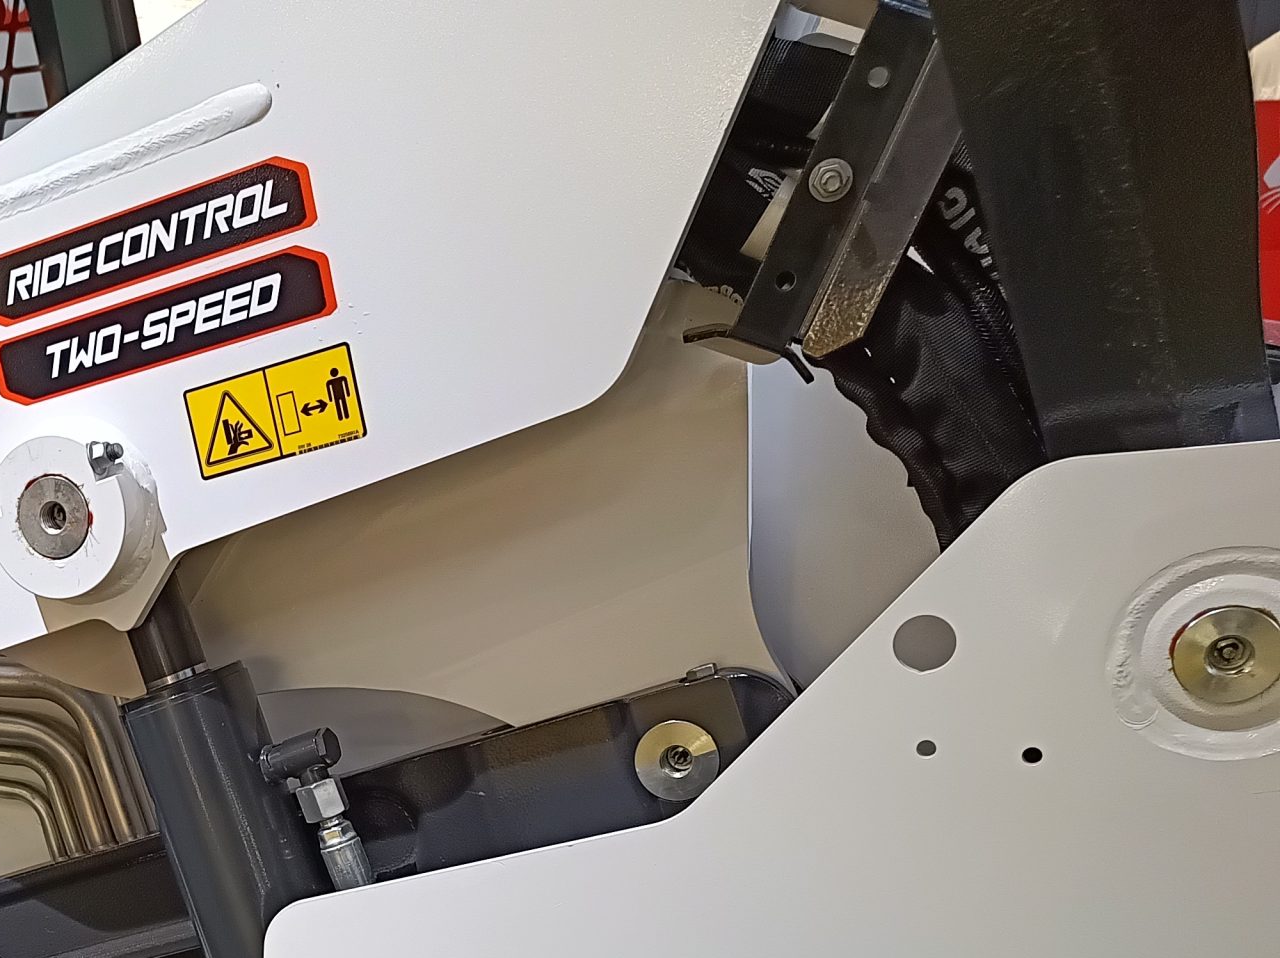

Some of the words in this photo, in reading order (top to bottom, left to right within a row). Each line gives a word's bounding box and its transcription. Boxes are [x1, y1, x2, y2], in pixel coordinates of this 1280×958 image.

[6, 241, 94, 306] RIDE
[96, 179, 290, 276] CONTROL
[45, 272, 282, 380] TWO-SPEED
